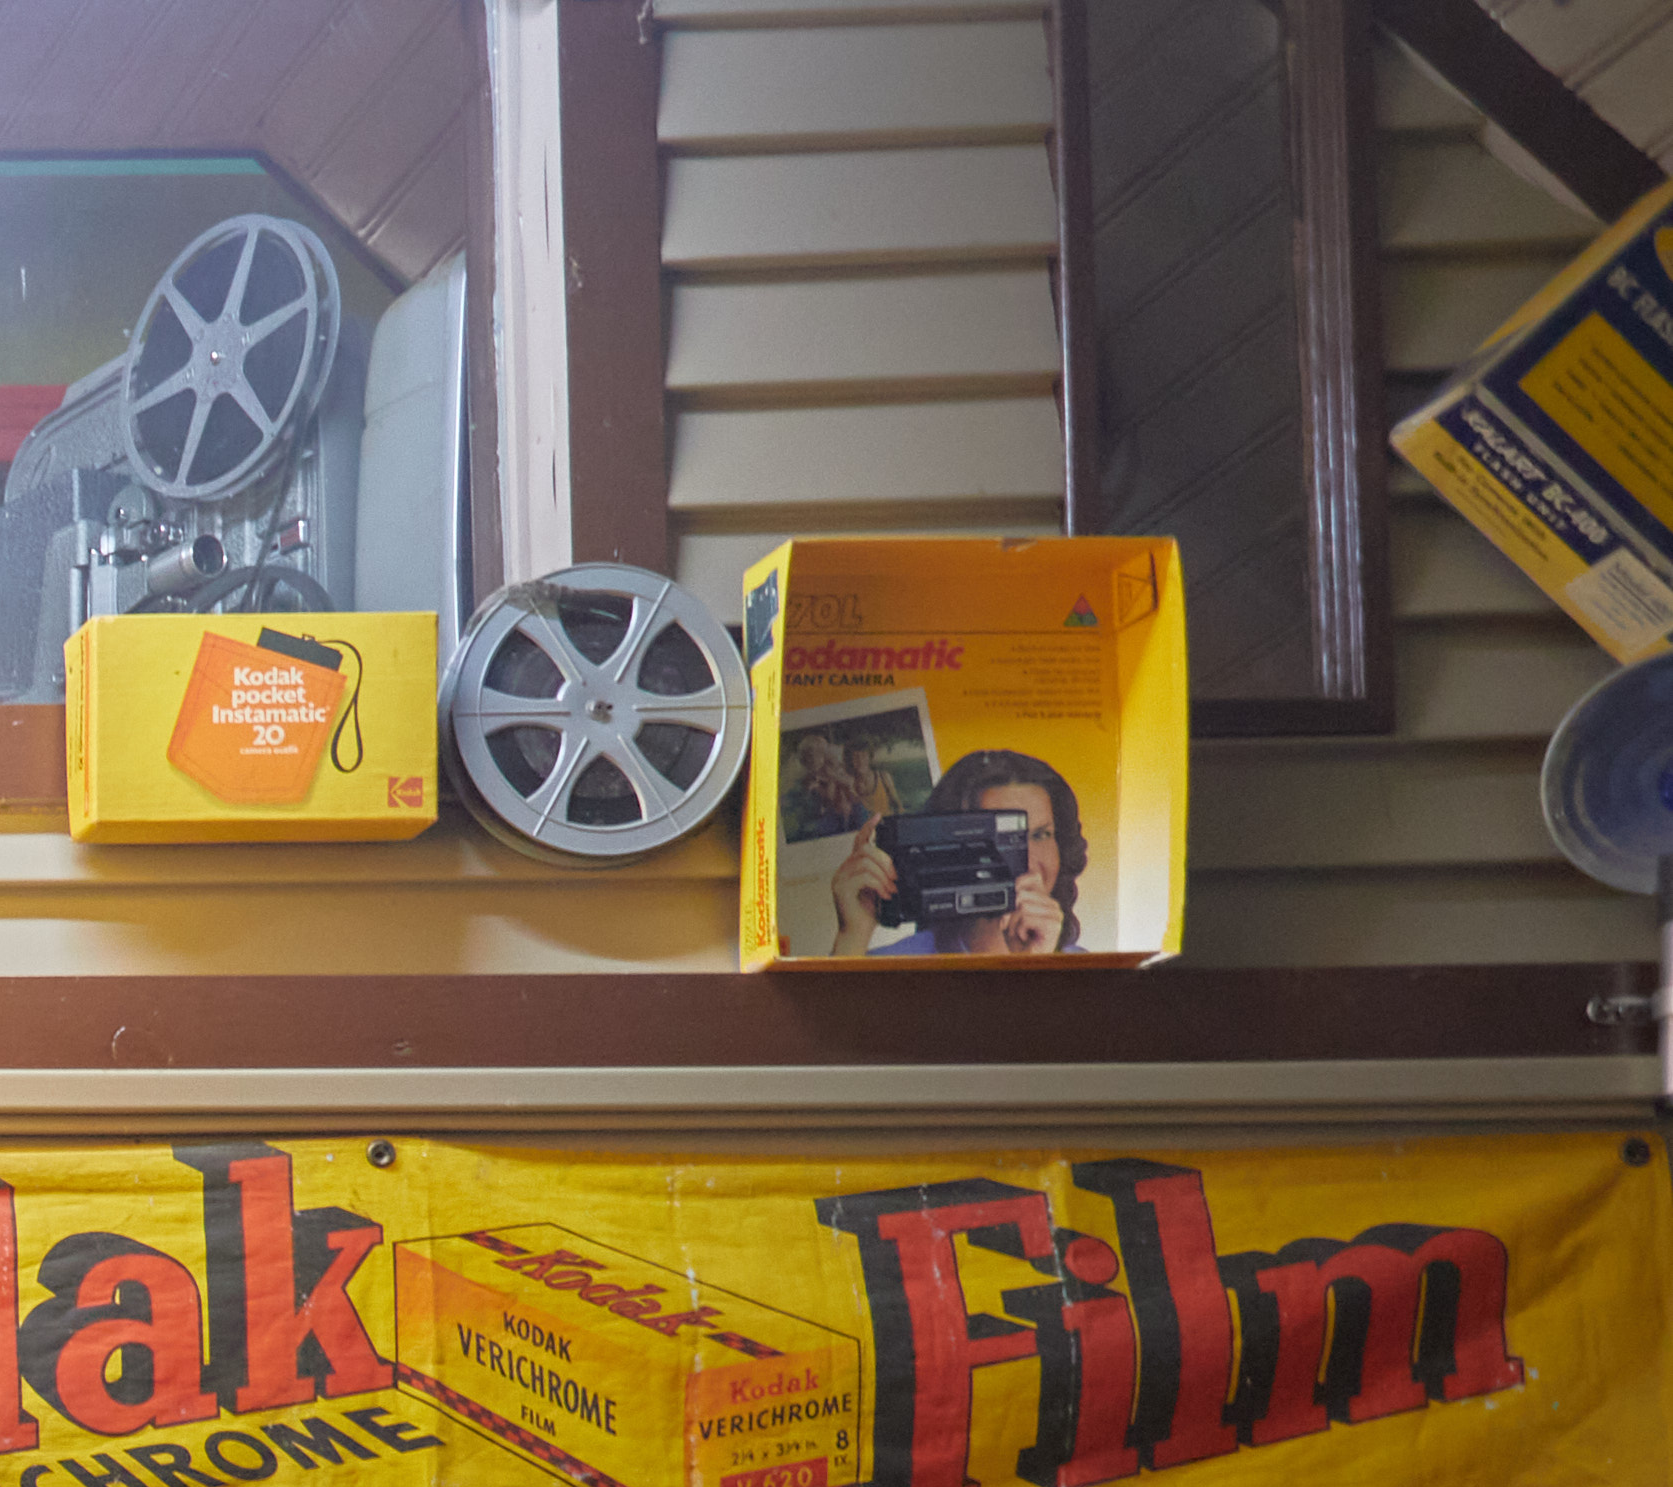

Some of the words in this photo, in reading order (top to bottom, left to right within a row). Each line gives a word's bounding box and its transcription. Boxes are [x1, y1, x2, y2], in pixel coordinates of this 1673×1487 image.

[1541, 481, 1611, 546] BC-400
[784, 639, 965, 672] odamatic
[233, 666, 305, 686] Kodak
[828, 674, 895, 687] CAMERA
[212, 703, 327, 724] Instamatic
[232, 686, 308, 709] pocket
[252, 725, 286, 746] 20
[755, 816, 767, 948] Kodamatic
[493, 1249, 724, 1338] Kodak
[503, 1311, 573, 1363] KODAK
[457, 1323, 618, 1437] VERICHROME
[729, 1367, 820, 1405] Kodak
[520, 1404, 557, 1438] FILM
[698, 1392, 853, 1441] VERICHROME
[835, 1429, 851, 1451] 8
